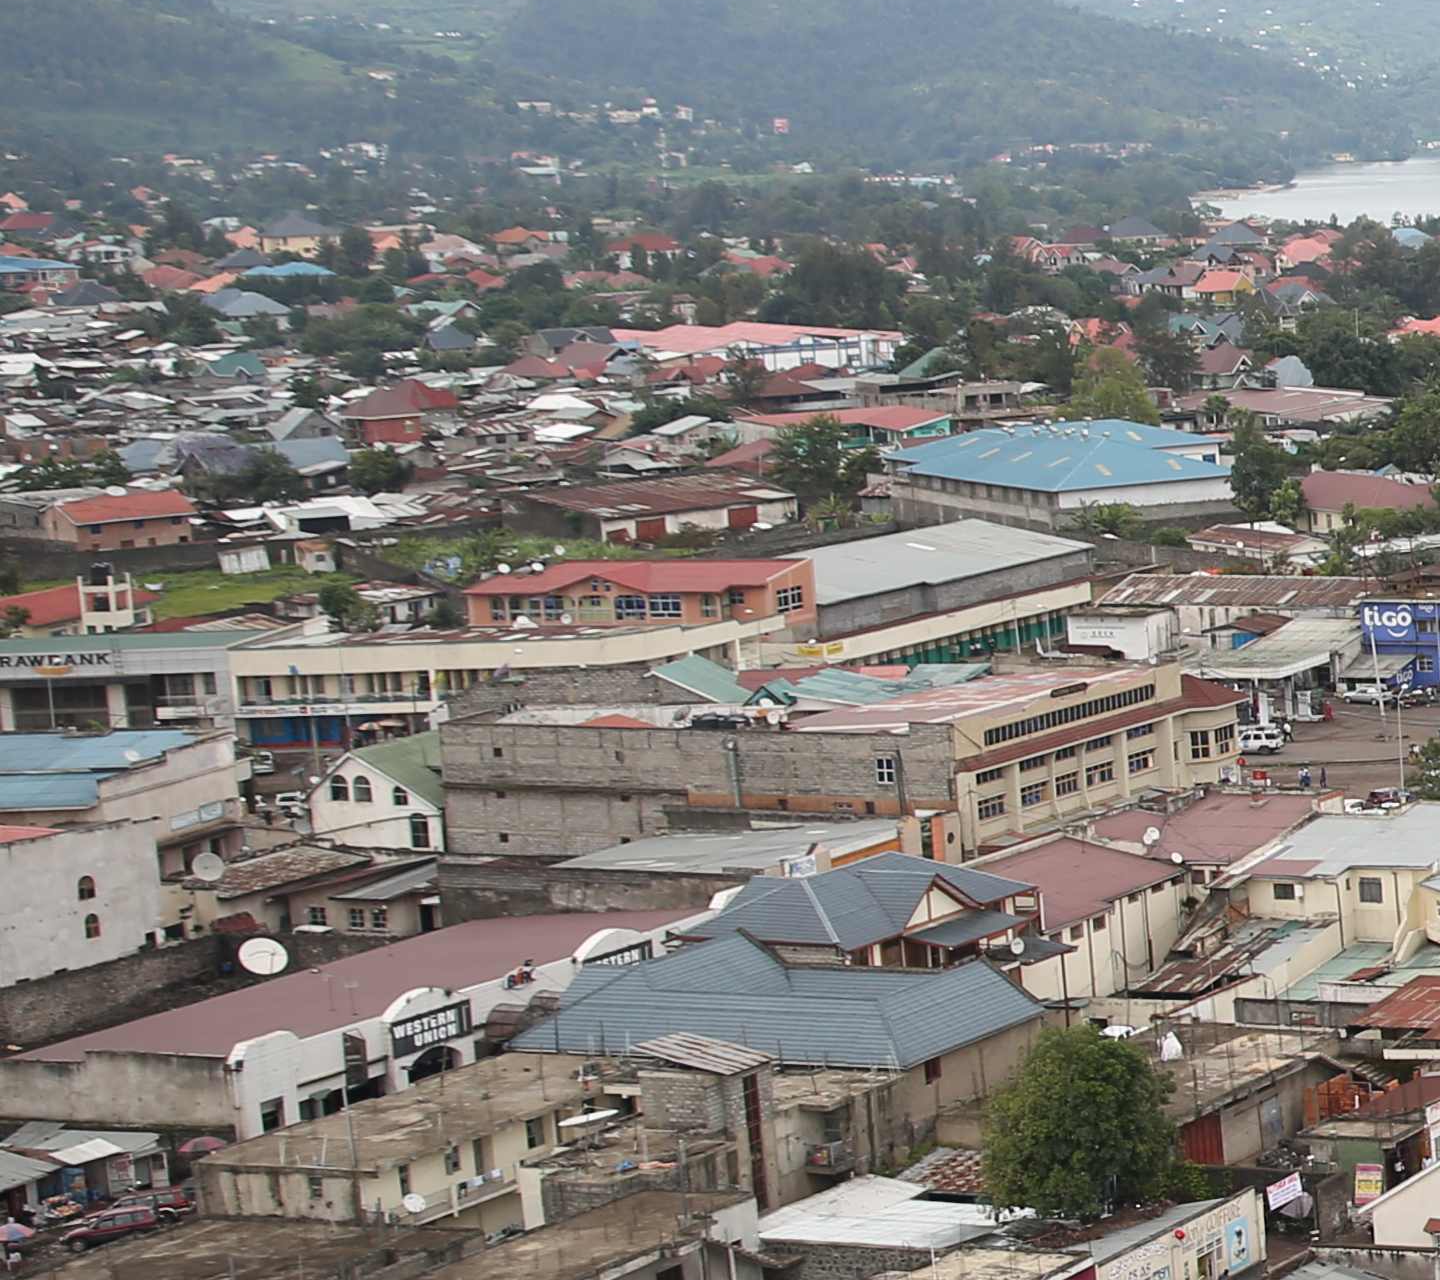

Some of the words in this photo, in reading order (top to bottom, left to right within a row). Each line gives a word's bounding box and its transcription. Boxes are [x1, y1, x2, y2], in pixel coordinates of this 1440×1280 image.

[1364, 605, 1413, 628] tigo
[596, 949, 640, 966] STERN
[393, 1009, 456, 1039] WESTERN
[414, 1023, 458, 1047] UNION
